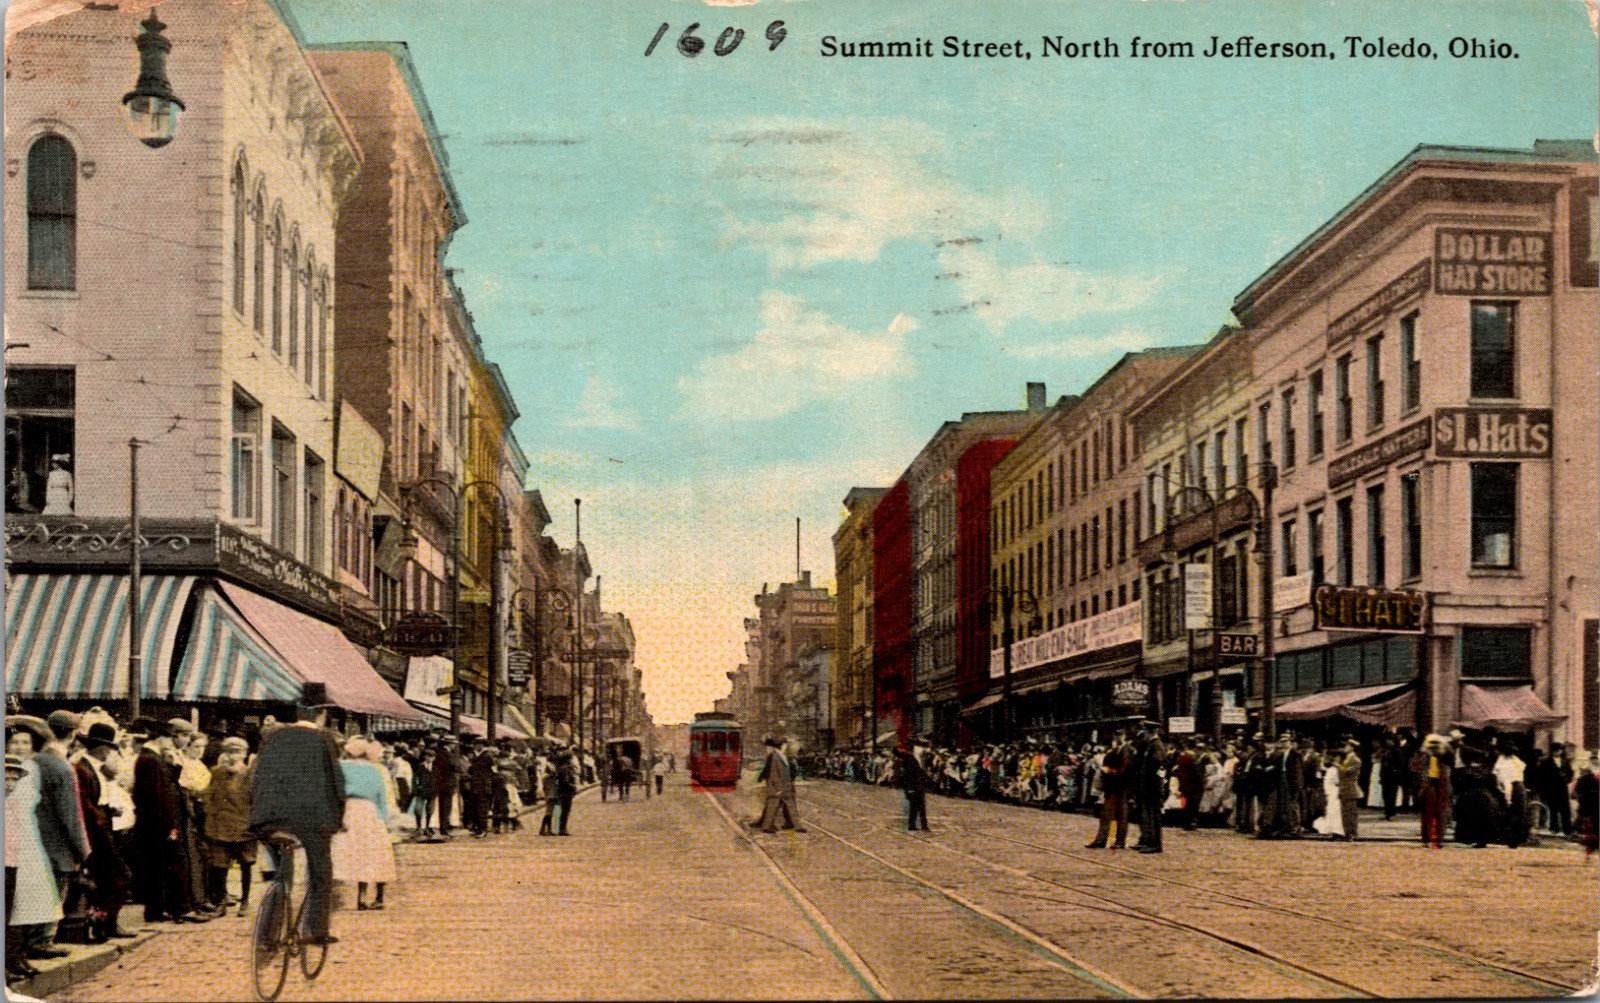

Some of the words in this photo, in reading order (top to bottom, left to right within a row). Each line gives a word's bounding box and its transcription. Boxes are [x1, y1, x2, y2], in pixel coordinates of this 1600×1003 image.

[1440, 233, 1545, 262] DOLLAR
[1440, 264, 1478, 290] HAT
[1482, 264, 1547, 292] STORE
[1355, 597, 1421, 627] HATS
[1220, 635, 1256, 653] BAR
[1113, 681, 1149, 696] ADAMS
